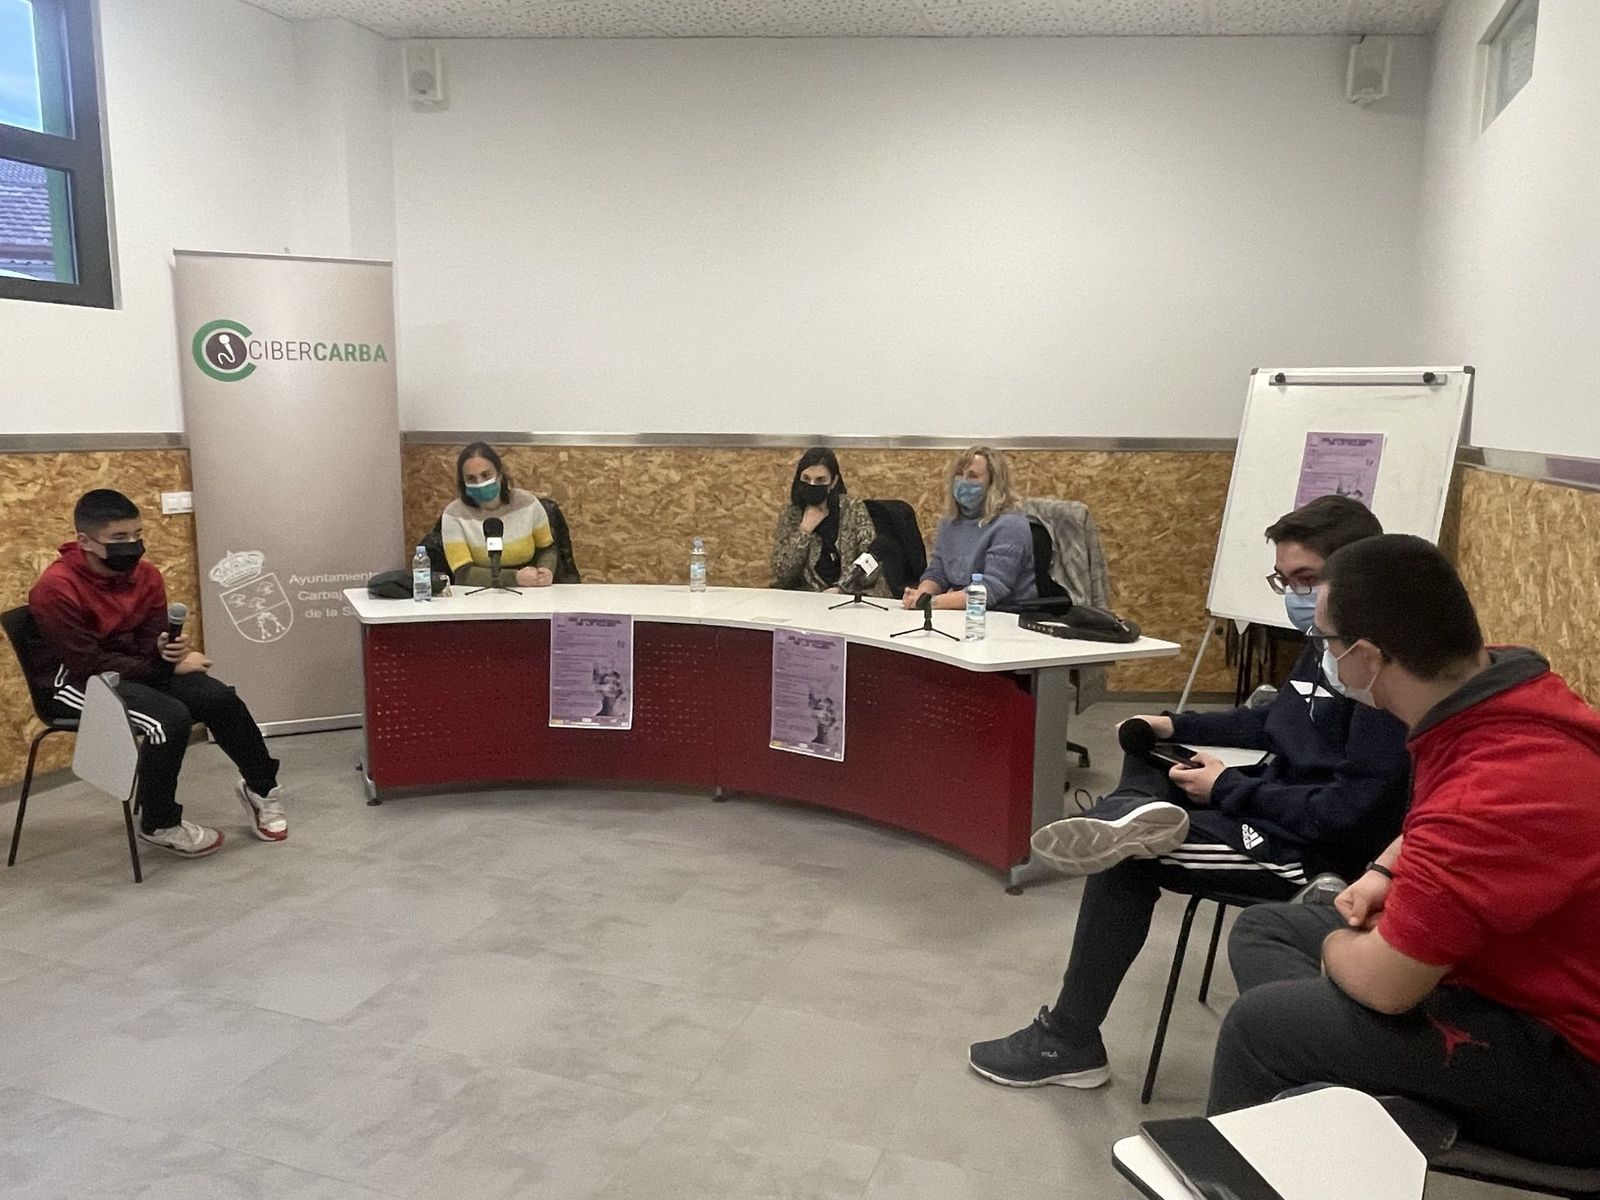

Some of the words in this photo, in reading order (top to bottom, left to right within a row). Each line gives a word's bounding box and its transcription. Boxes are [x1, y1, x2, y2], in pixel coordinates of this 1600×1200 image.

[248, 340, 388, 362] CIBERCARBA
[298, 588, 343, 601] Carbaj
[305, 609, 322, 618] de
[326, 608, 338, 617] la
